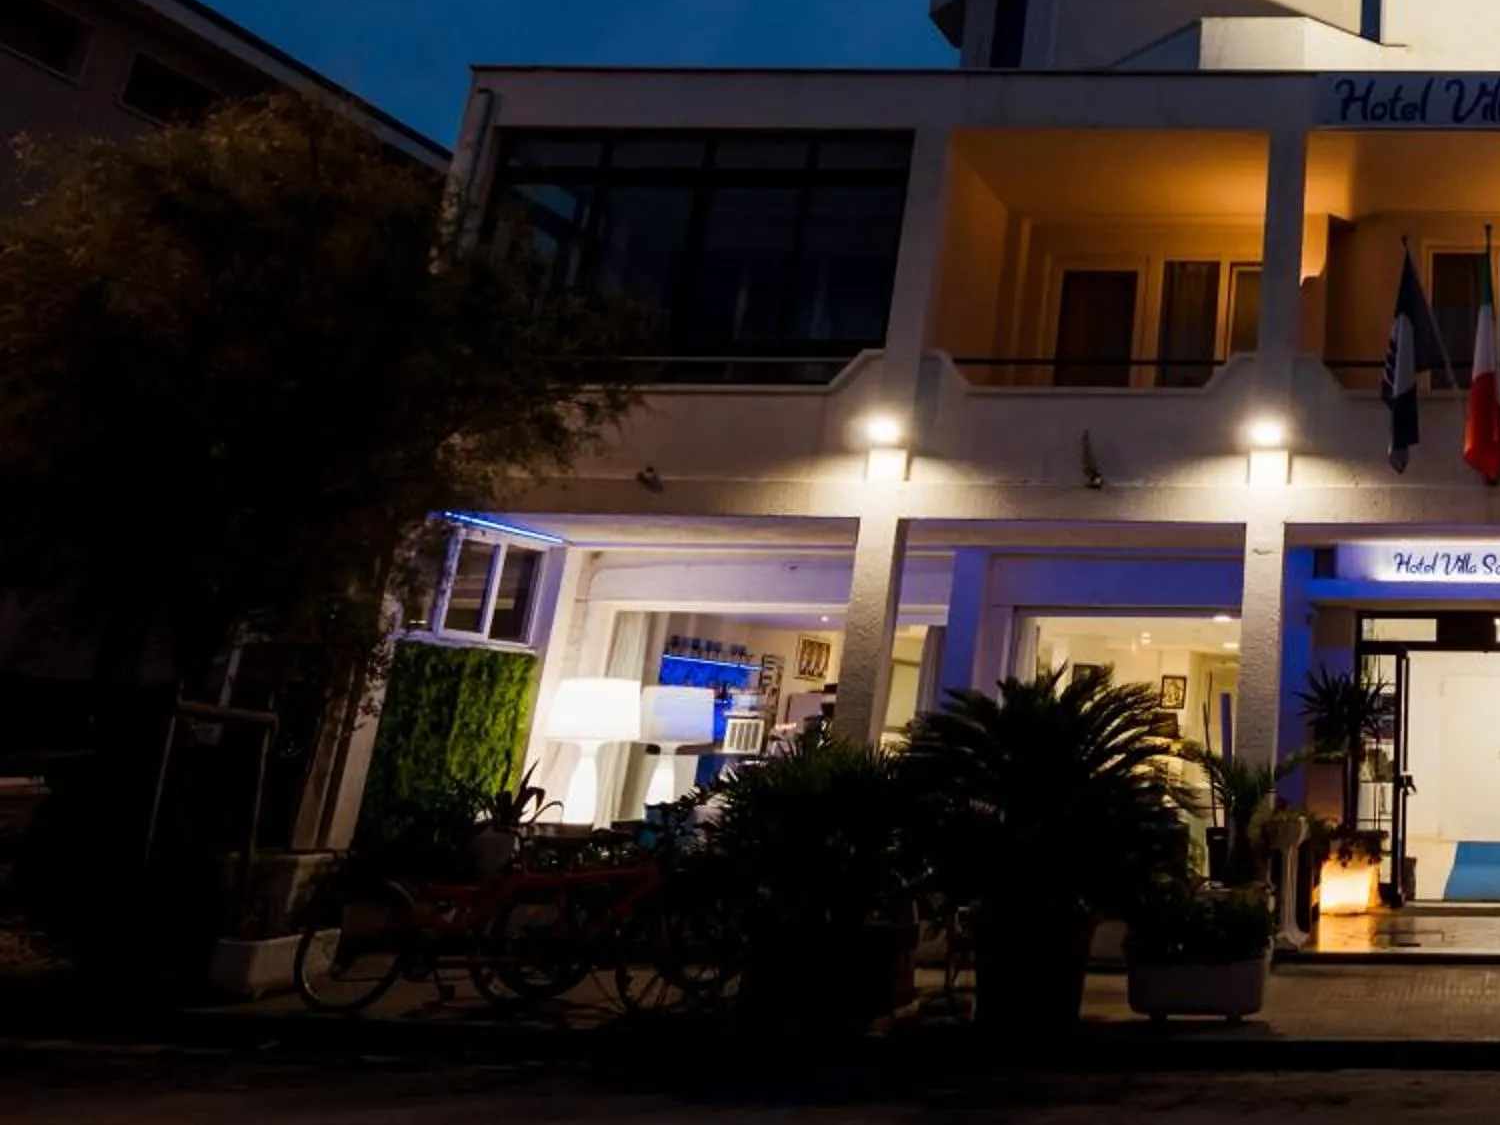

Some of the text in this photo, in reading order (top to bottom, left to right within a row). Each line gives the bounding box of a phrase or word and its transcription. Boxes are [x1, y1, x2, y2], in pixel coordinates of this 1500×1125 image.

[1335, 78, 1434, 122] Hotel
[1393, 551, 1439, 575] Hotel
[1441, 552, 1477, 576] Villa
